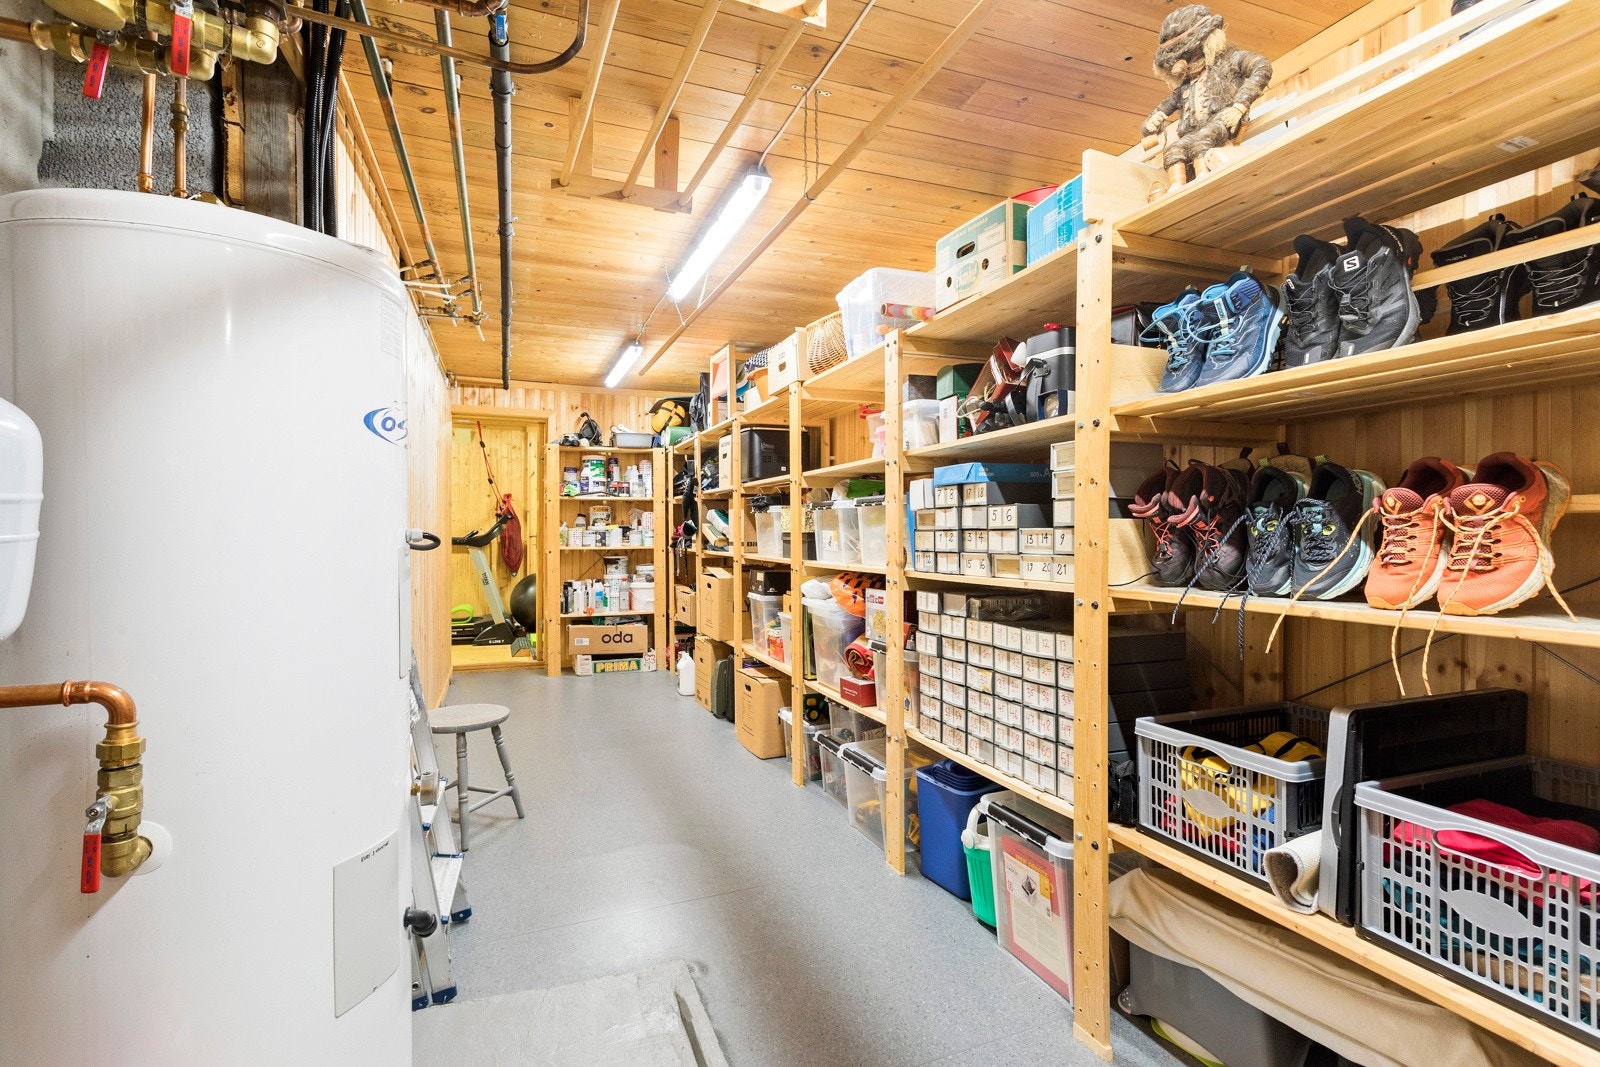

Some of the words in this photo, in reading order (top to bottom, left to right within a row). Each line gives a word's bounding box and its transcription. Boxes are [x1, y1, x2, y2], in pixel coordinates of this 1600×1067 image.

[936, 489, 942, 500] 7
[950, 488, 954, 500] 8
[966, 488, 972, 497] 17
[978, 487, 985, 498] 18
[991, 509, 998, 521] 5
[1006, 508, 1013, 522] 6
[948, 532, 954, 542] 2
[967, 532, 973, 542] 3
[978, 532, 984, 543] 4
[1026, 534, 1034, 545] 13
[1041, 532, 1049, 544] 14
[1059, 533, 1066, 546] 9
[916, 554, 921, 563] 11
[926, 554, 932, 565] 12
[965, 559, 972, 569] 15
[979, 558, 986, 570] 16
[1027, 562, 1033, 572] 19
[1056, 563, 1067, 576] 21
[601, 631, 633, 644] oda
[1042, 638, 1050, 649] 12
[1059, 639, 1067, 651] 13
[596, 660, 638, 673] PRIMA
[998, 704, 1006, 712] 45
[1010, 706, 1018, 720] 46
[1061, 724, 1072, 737] 49
